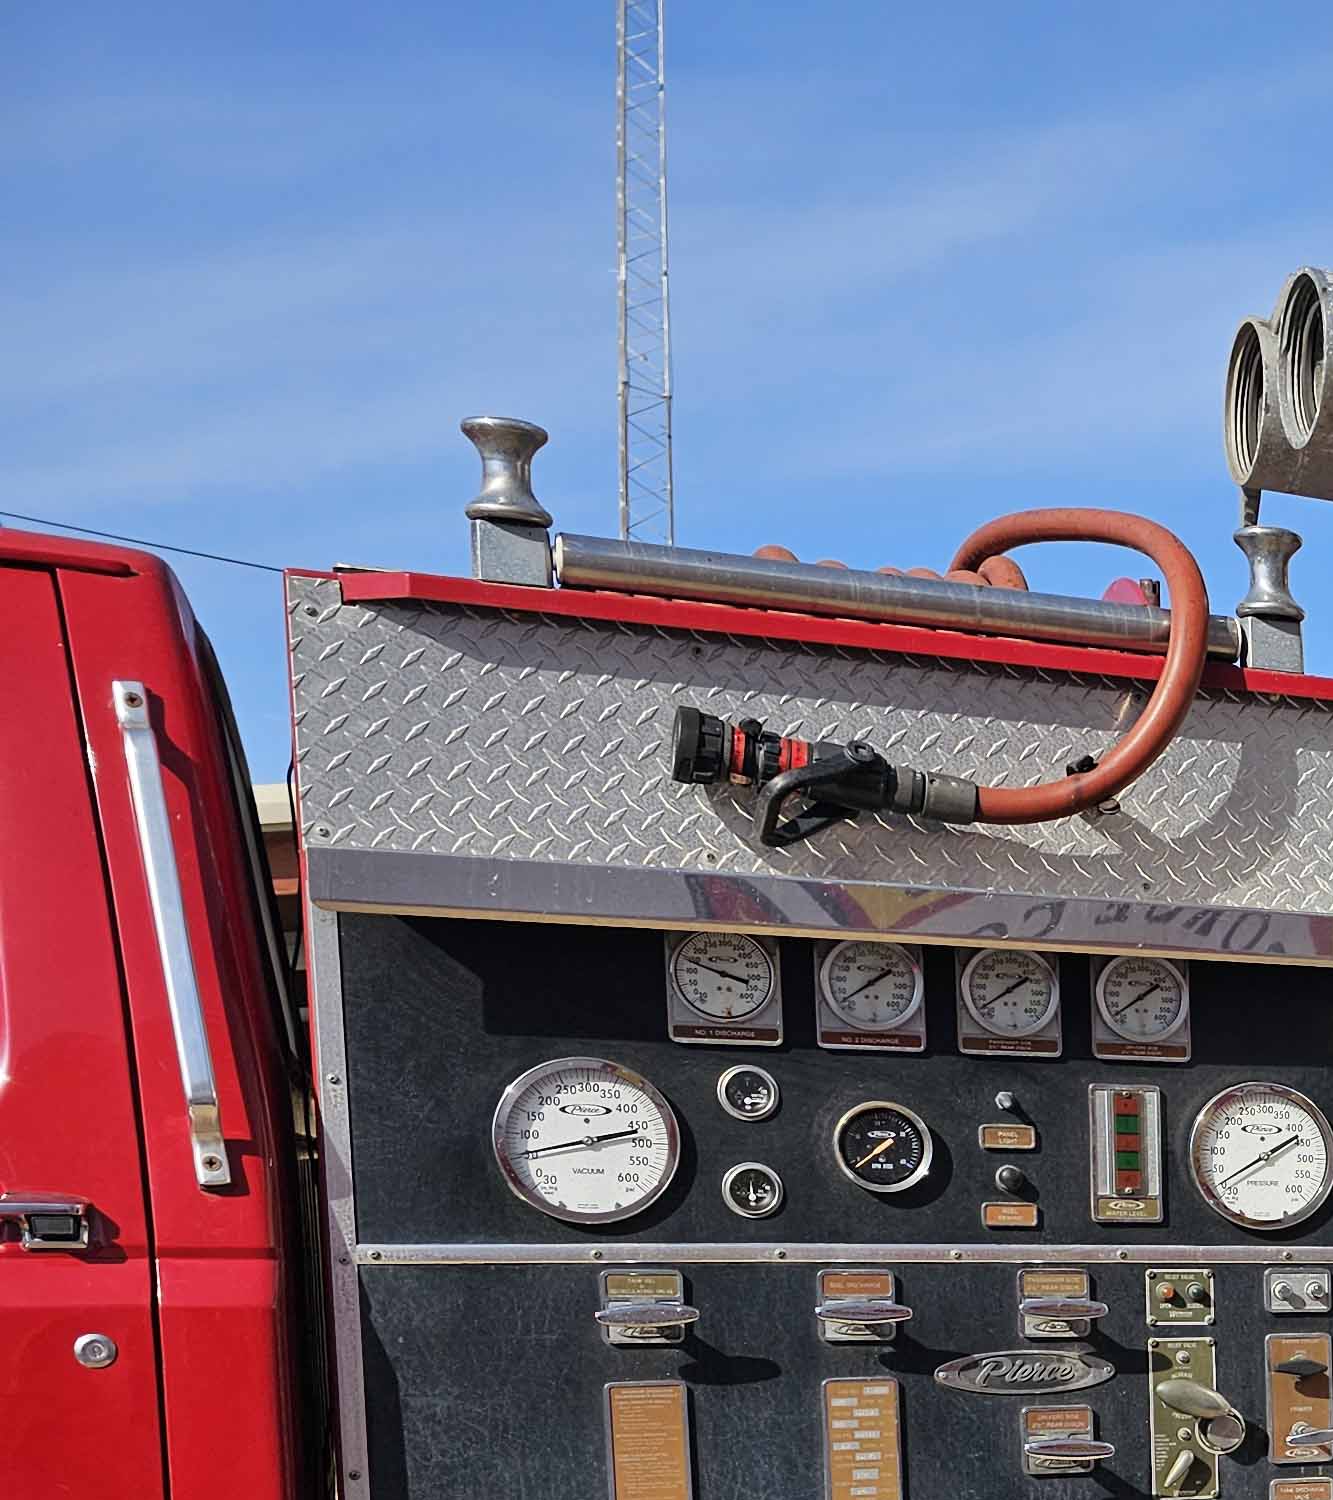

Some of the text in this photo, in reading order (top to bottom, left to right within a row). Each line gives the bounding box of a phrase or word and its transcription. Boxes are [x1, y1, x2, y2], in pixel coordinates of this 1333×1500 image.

[555, 1084, 577, 1095] 250
[577, 1083, 600, 1093] 300
[599, 1089, 621, 1099] 350
[538, 1096, 561, 1106] 200
[615, 1104, 638, 1114] 400
[1239, 1107, 1256, 1116] 250
[1256, 1105, 1274, 1114] 300
[526, 1112, 545, 1121] 150
[1273, 1111, 1290, 1120] 350
[627, 1120, 648, 1130] 450
[1224, 1117, 1243, 1126] 200
[1285, 1123, 1303, 1133] 400
[520, 1130, 540, 1139] 100
[1215, 1131, 1230, 1140] 150
[631, 1138, 653, 1149] 500
[1295, 1138, 1311, 1147] 450
[1210, 1147, 1225, 1156] 100
[628, 1156, 649, 1166] 550
[1296, 1154, 1314, 1163] 500
[572, 1167, 605, 1175] VACUUM
[1212, 1165, 1224, 1174] 50
[617, 1173, 639, 1183] 600
[1294, 1170, 1311, 1179] 550
[543, 1175, 557, 1185] 30
[1227, 1187, 1239, 1196] 30
[1285, 1184, 1303, 1193] 600
[976, 1357, 1076, 1388] Pierce
